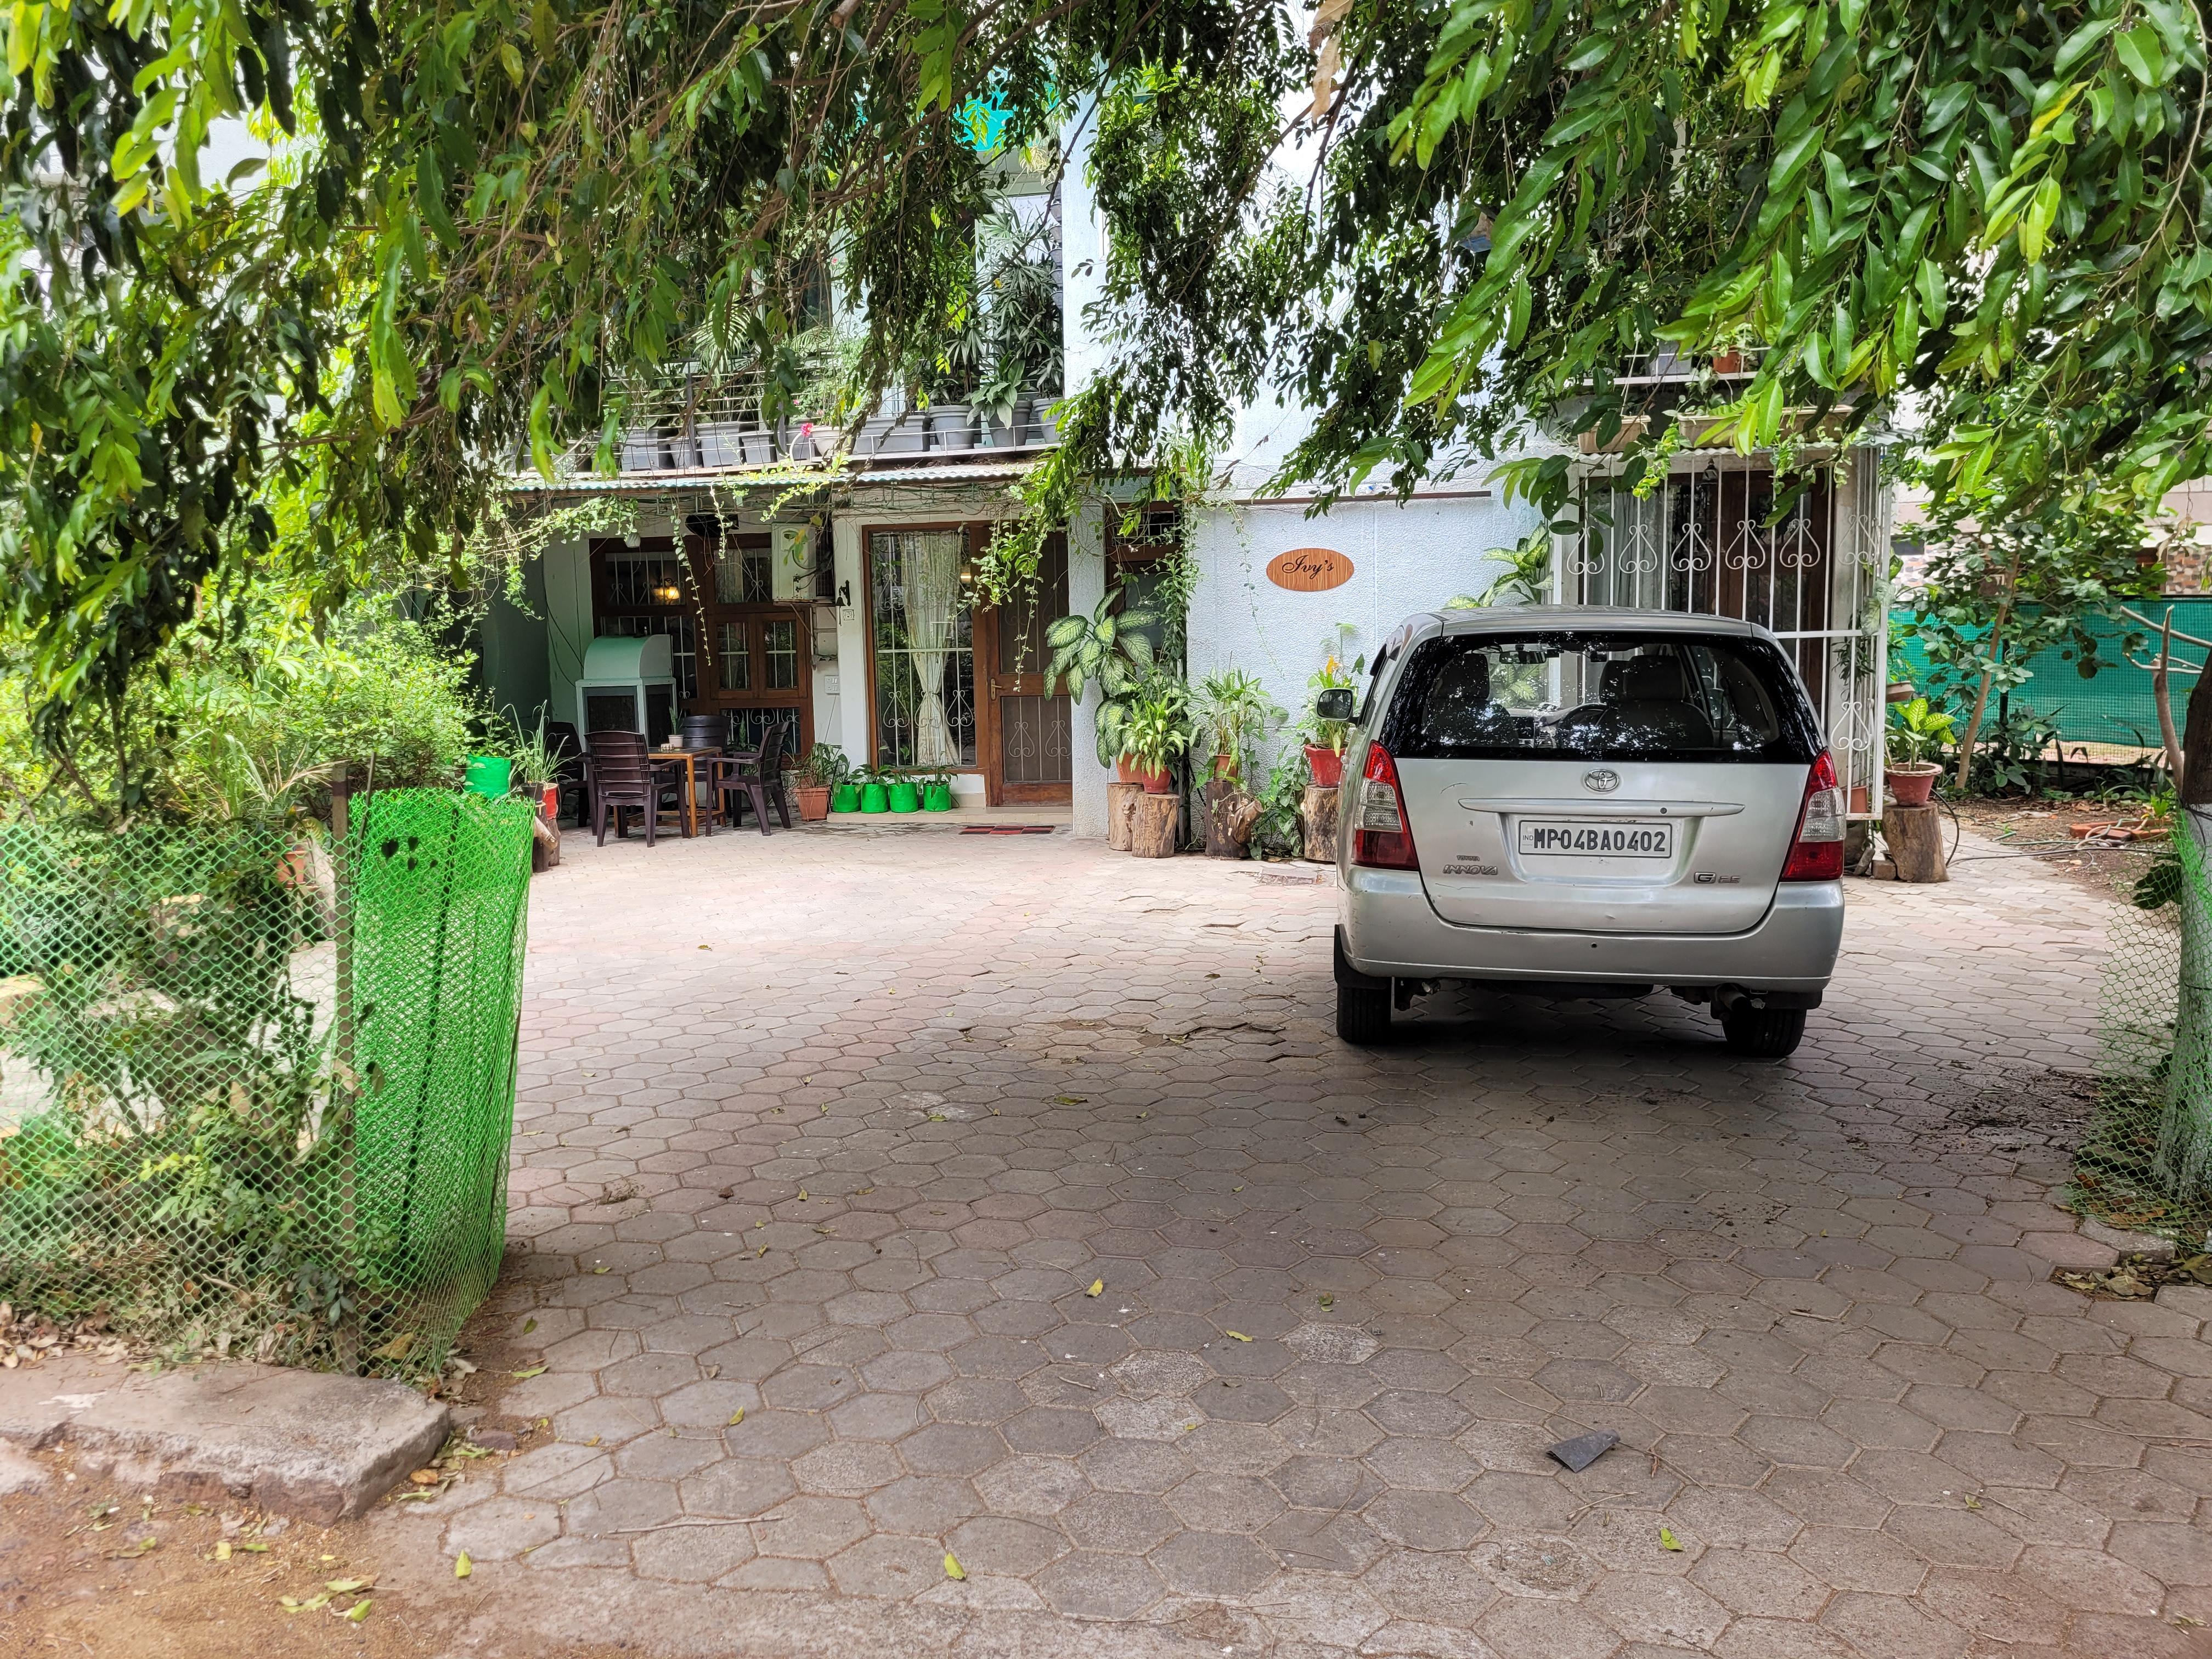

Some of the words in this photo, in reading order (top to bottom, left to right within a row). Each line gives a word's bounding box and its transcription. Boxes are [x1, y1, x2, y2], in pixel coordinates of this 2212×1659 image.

[1282, 555, 1334, 579] Ivy's
[1534, 828, 1666, 852] MP04BA0402
[1442, 865, 1498, 875] INNOVA
[1696, 873, 1715, 883] G
